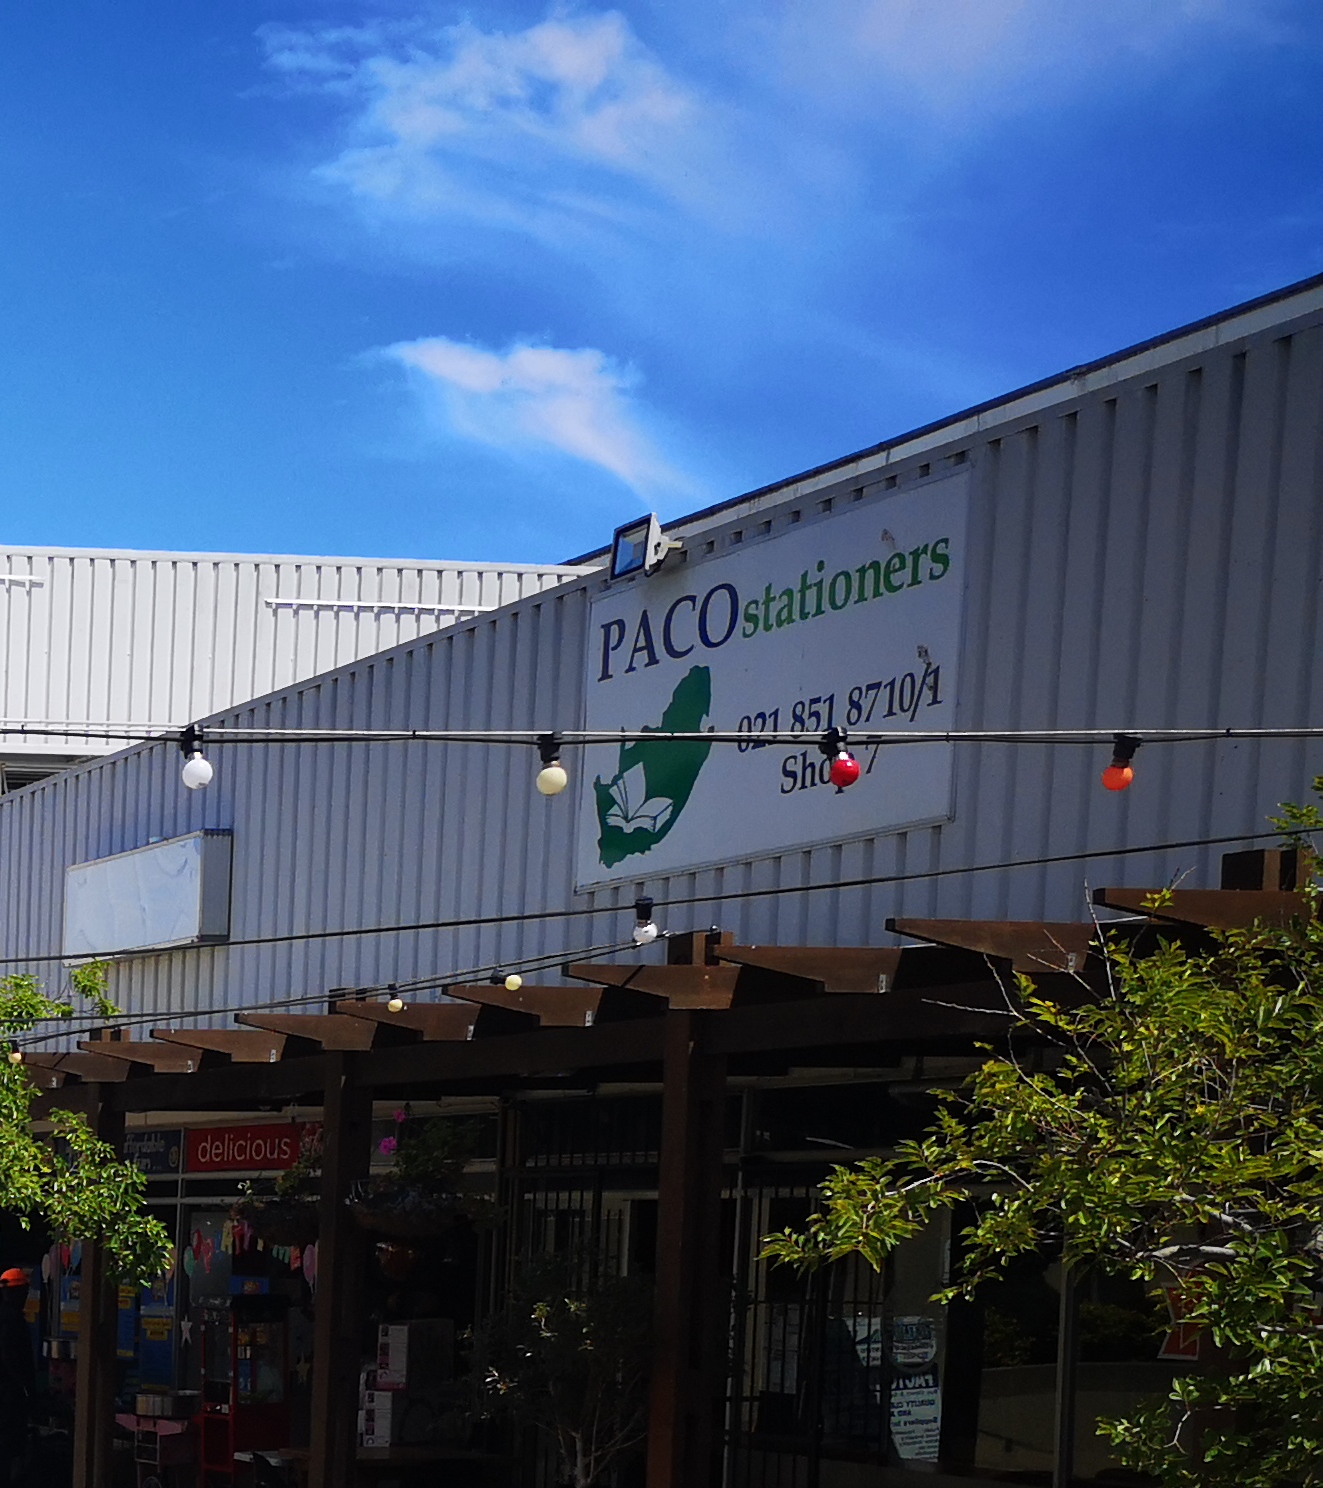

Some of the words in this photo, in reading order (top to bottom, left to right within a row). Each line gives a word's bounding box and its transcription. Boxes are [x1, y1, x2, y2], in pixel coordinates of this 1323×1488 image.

[737, 707, 779, 752] 021
[791, 693, 834, 738] 851
[197, 1133, 291, 1163] delicious
